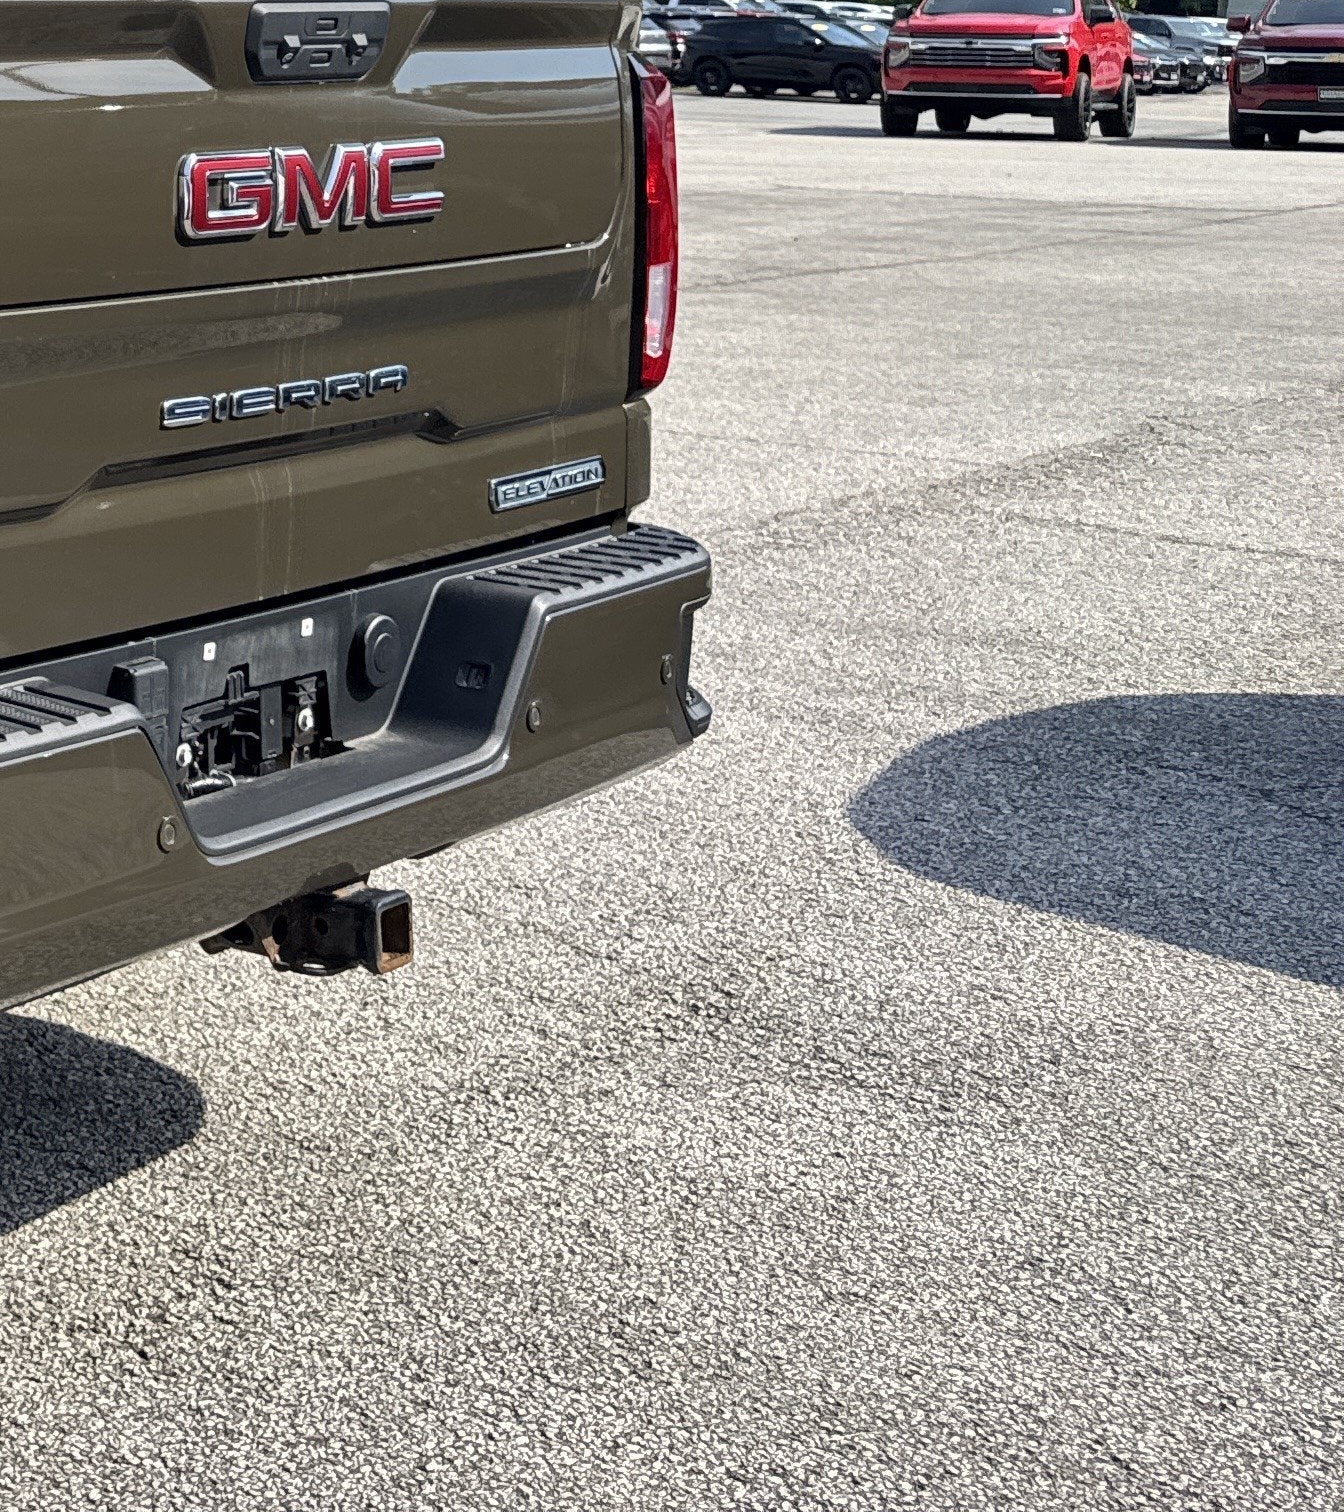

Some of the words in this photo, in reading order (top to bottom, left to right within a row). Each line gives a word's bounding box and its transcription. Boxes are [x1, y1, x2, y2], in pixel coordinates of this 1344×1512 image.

[175, 137, 445, 241] GMC
[160, 363, 409, 429] SIERRA
[499, 464, 600, 502] ELEVATION
